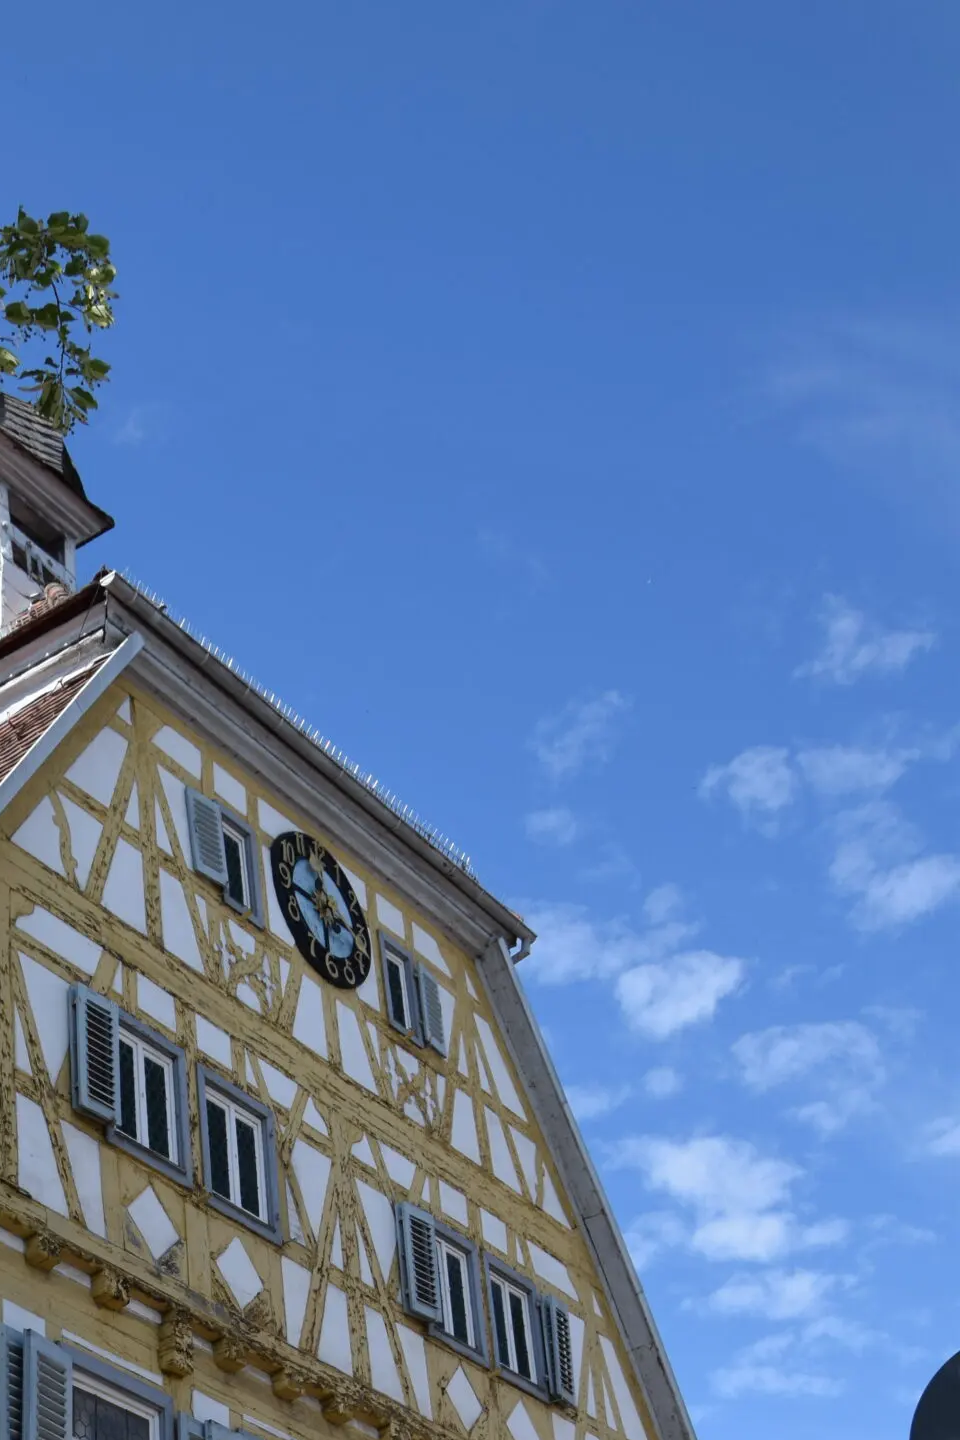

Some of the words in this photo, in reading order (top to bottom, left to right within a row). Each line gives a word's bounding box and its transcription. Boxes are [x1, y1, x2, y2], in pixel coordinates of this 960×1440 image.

[280, 839, 295, 865] 10
[294, 832, 305, 857] 11
[279, 862, 291, 889] 9
[333, 864, 341, 886] 1
[288, 895, 301, 922] 8
[348, 890, 360, 917] 2
[307, 931, 318, 958] 7
[325, 952, 339, 978] 6
[343, 958, 356, 985] 5
